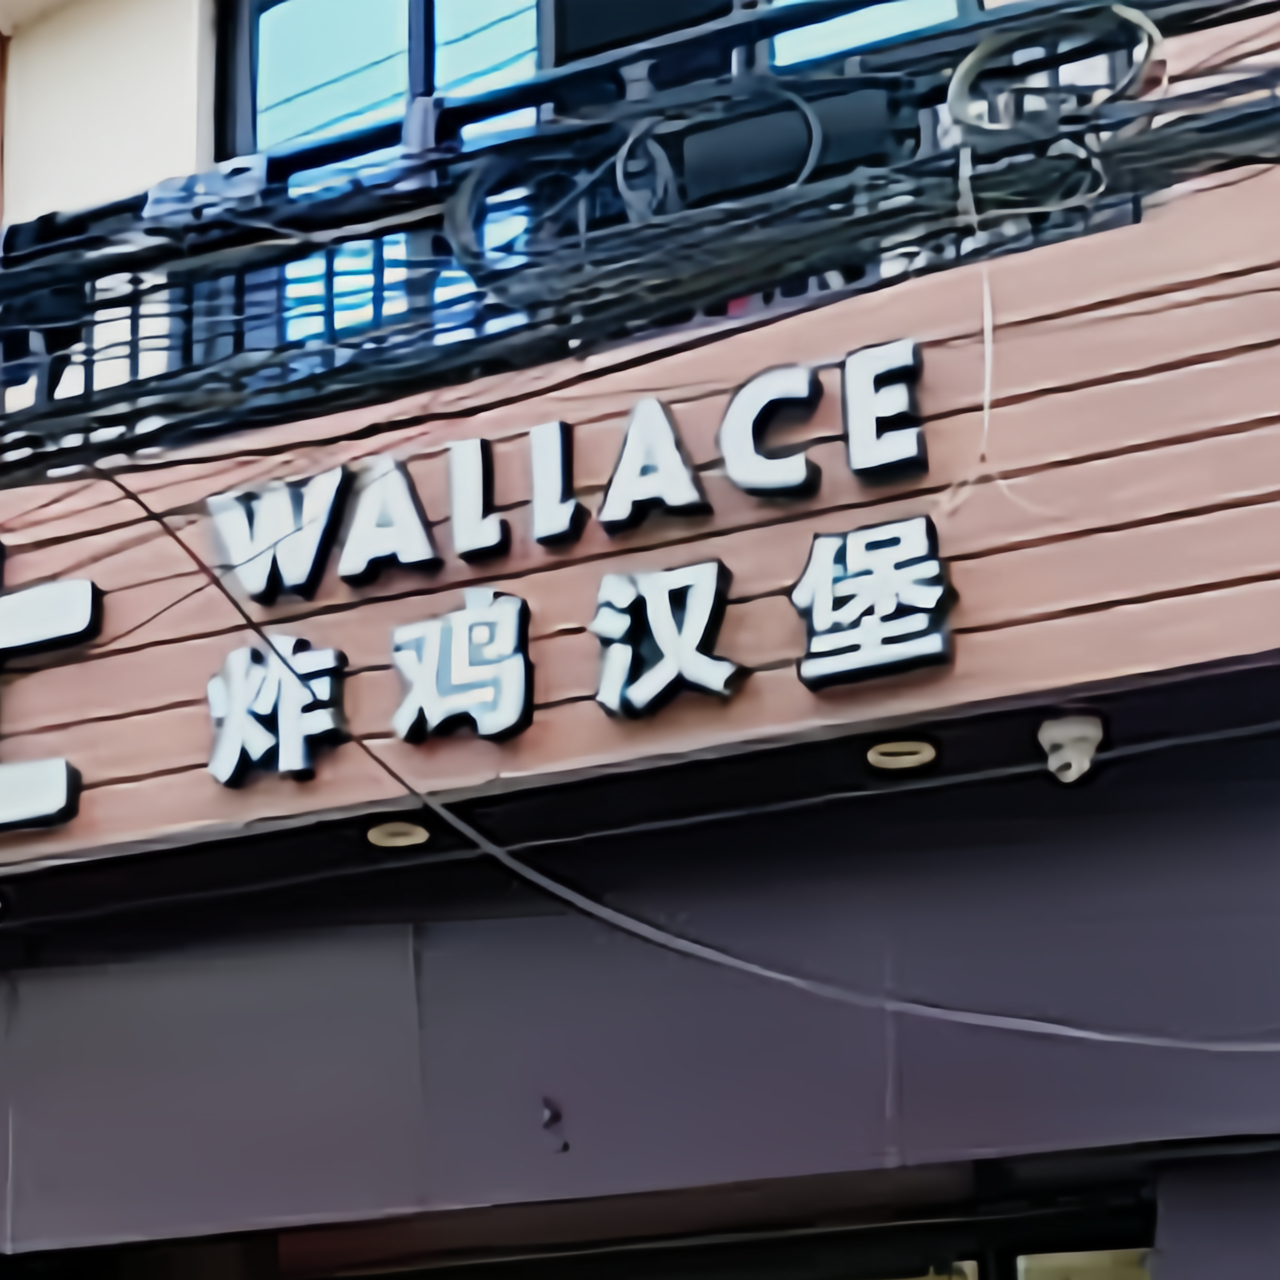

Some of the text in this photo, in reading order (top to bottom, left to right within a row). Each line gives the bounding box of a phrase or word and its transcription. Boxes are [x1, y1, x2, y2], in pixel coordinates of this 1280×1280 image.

[207, 338, 923, 598] WALLACE
[207, 515, 948, 785] 炸鸡汉堡
